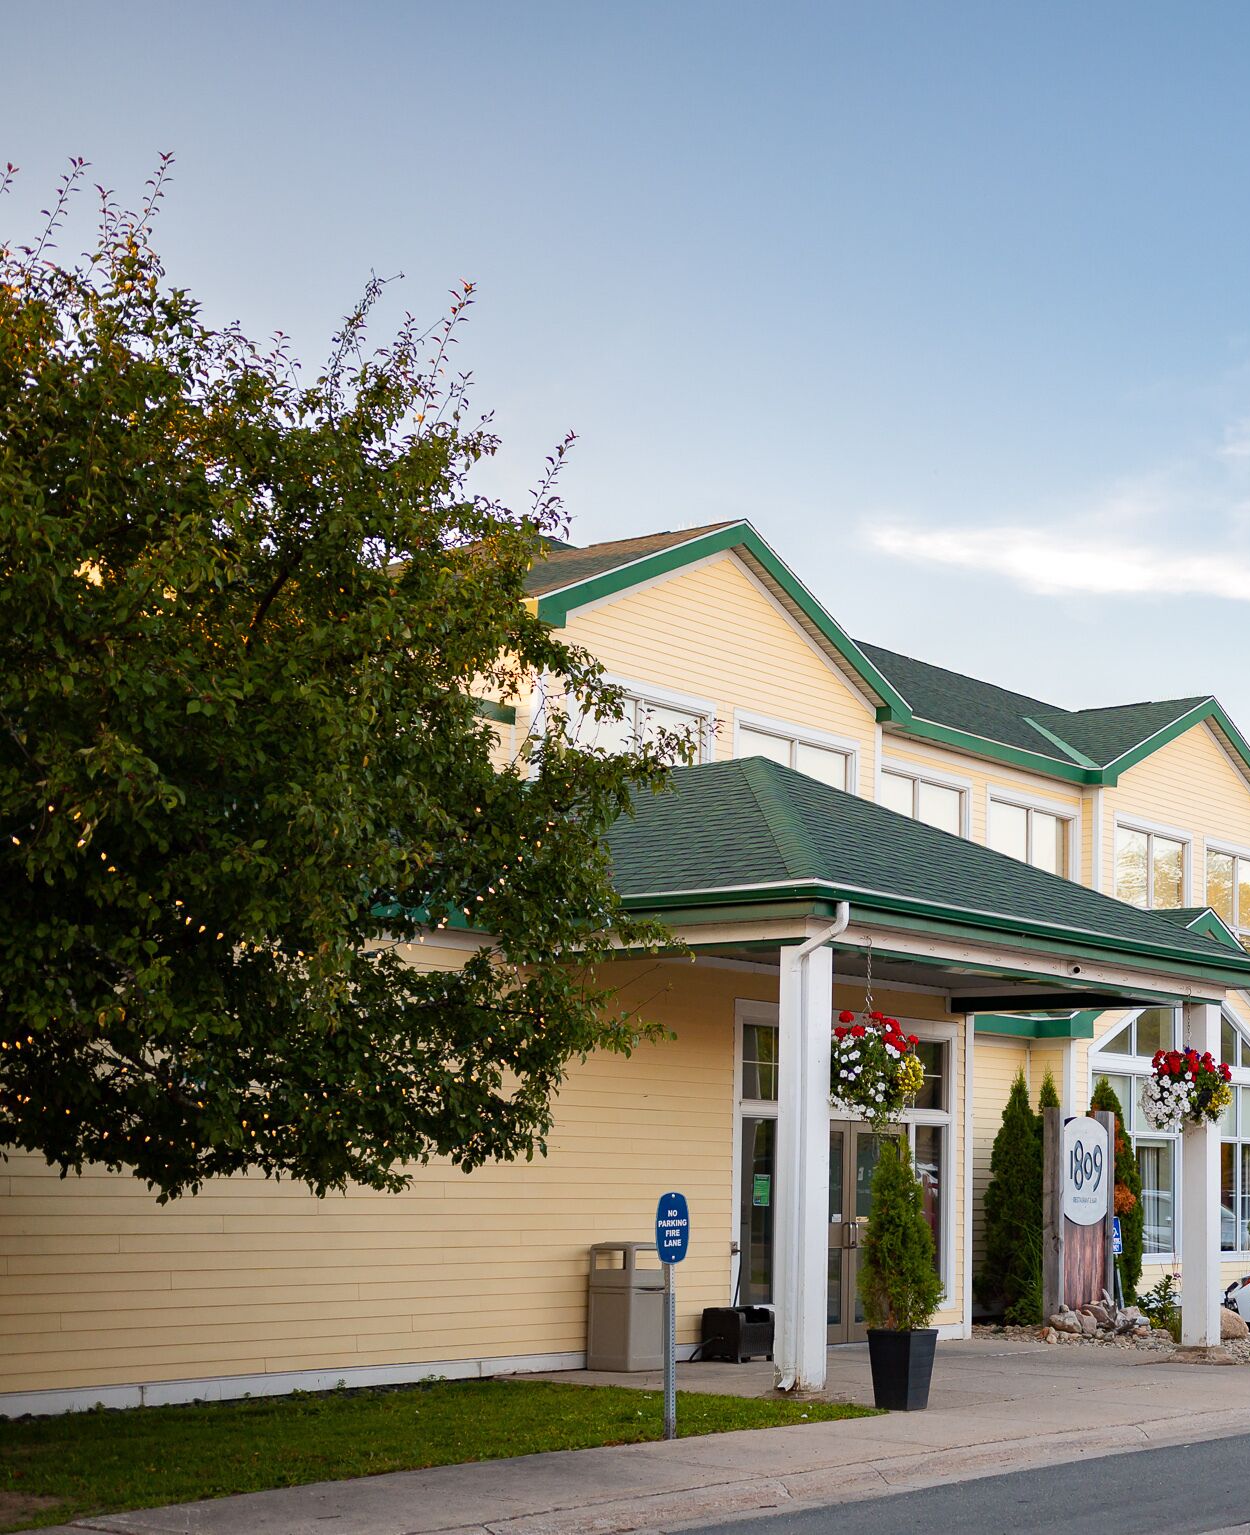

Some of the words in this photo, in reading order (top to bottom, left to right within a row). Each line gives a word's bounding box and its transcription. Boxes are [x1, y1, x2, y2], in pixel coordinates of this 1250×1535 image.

[1070, 1140, 1102, 1192] 1809
[658, 1219, 687, 1227] PARKING
[665, 1229, 680, 1237] FIRE
[664, 1239, 682, 1247] LANE
